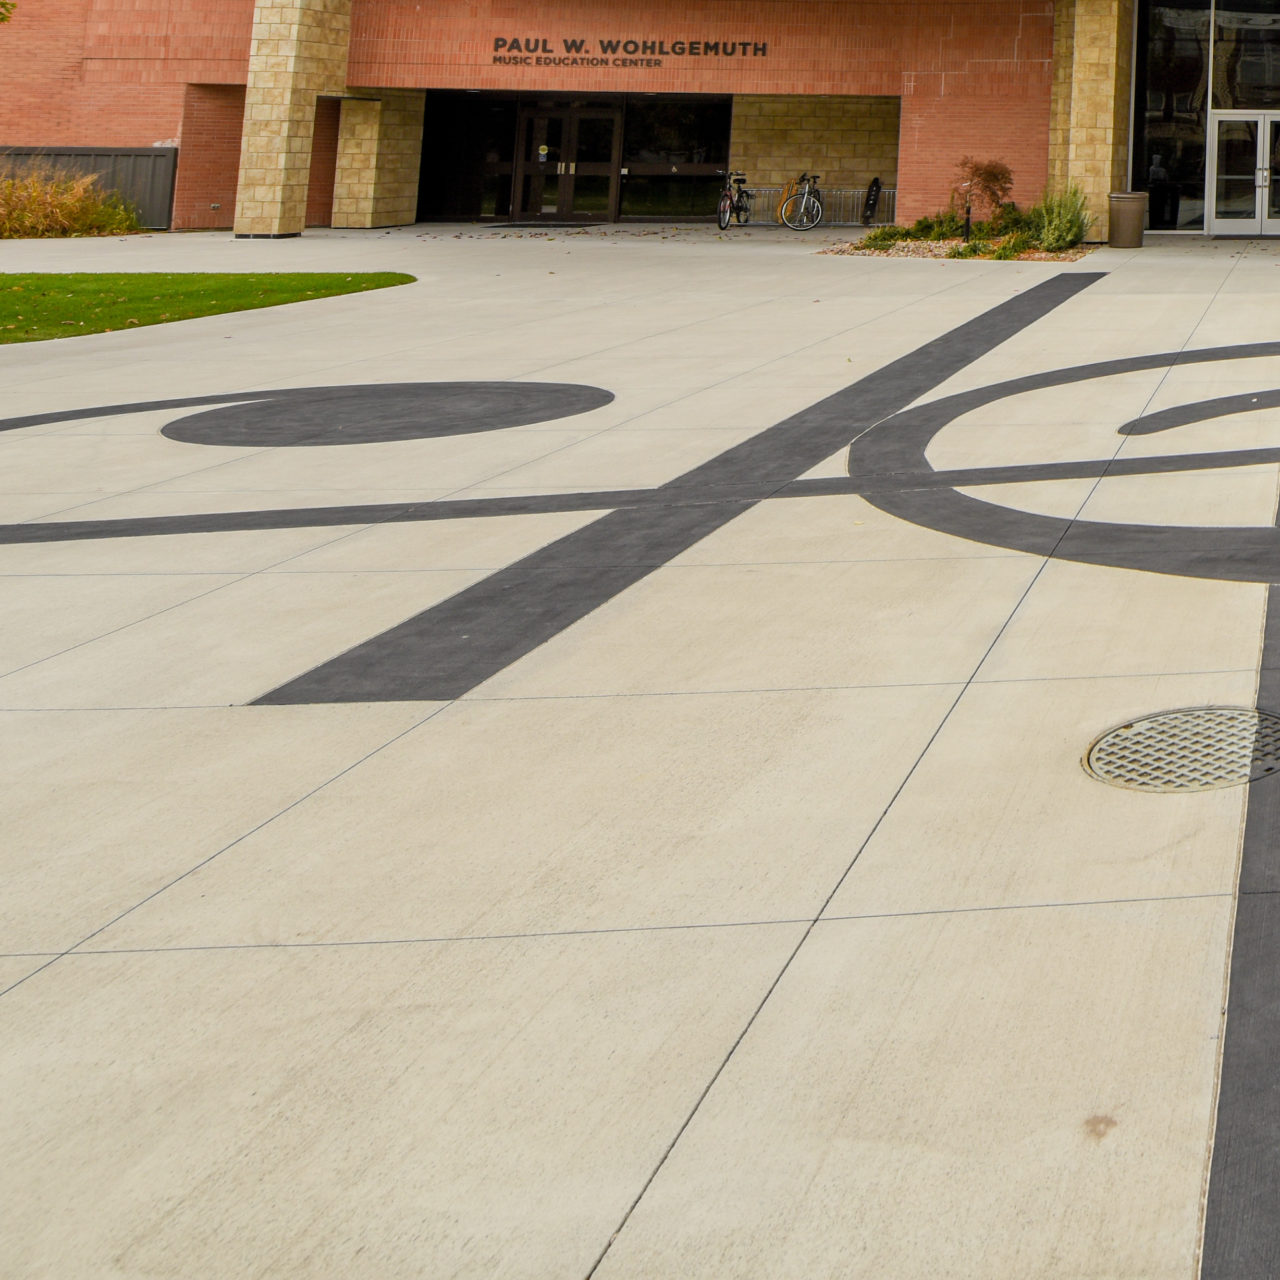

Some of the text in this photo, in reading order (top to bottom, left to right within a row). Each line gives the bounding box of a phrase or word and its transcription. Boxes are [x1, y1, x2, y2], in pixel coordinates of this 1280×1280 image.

[493, 37, 768, 57] PAUL W. WOHLGEMUTH
[492, 55, 662, 68] MUSIC EDUCATION CENTER
